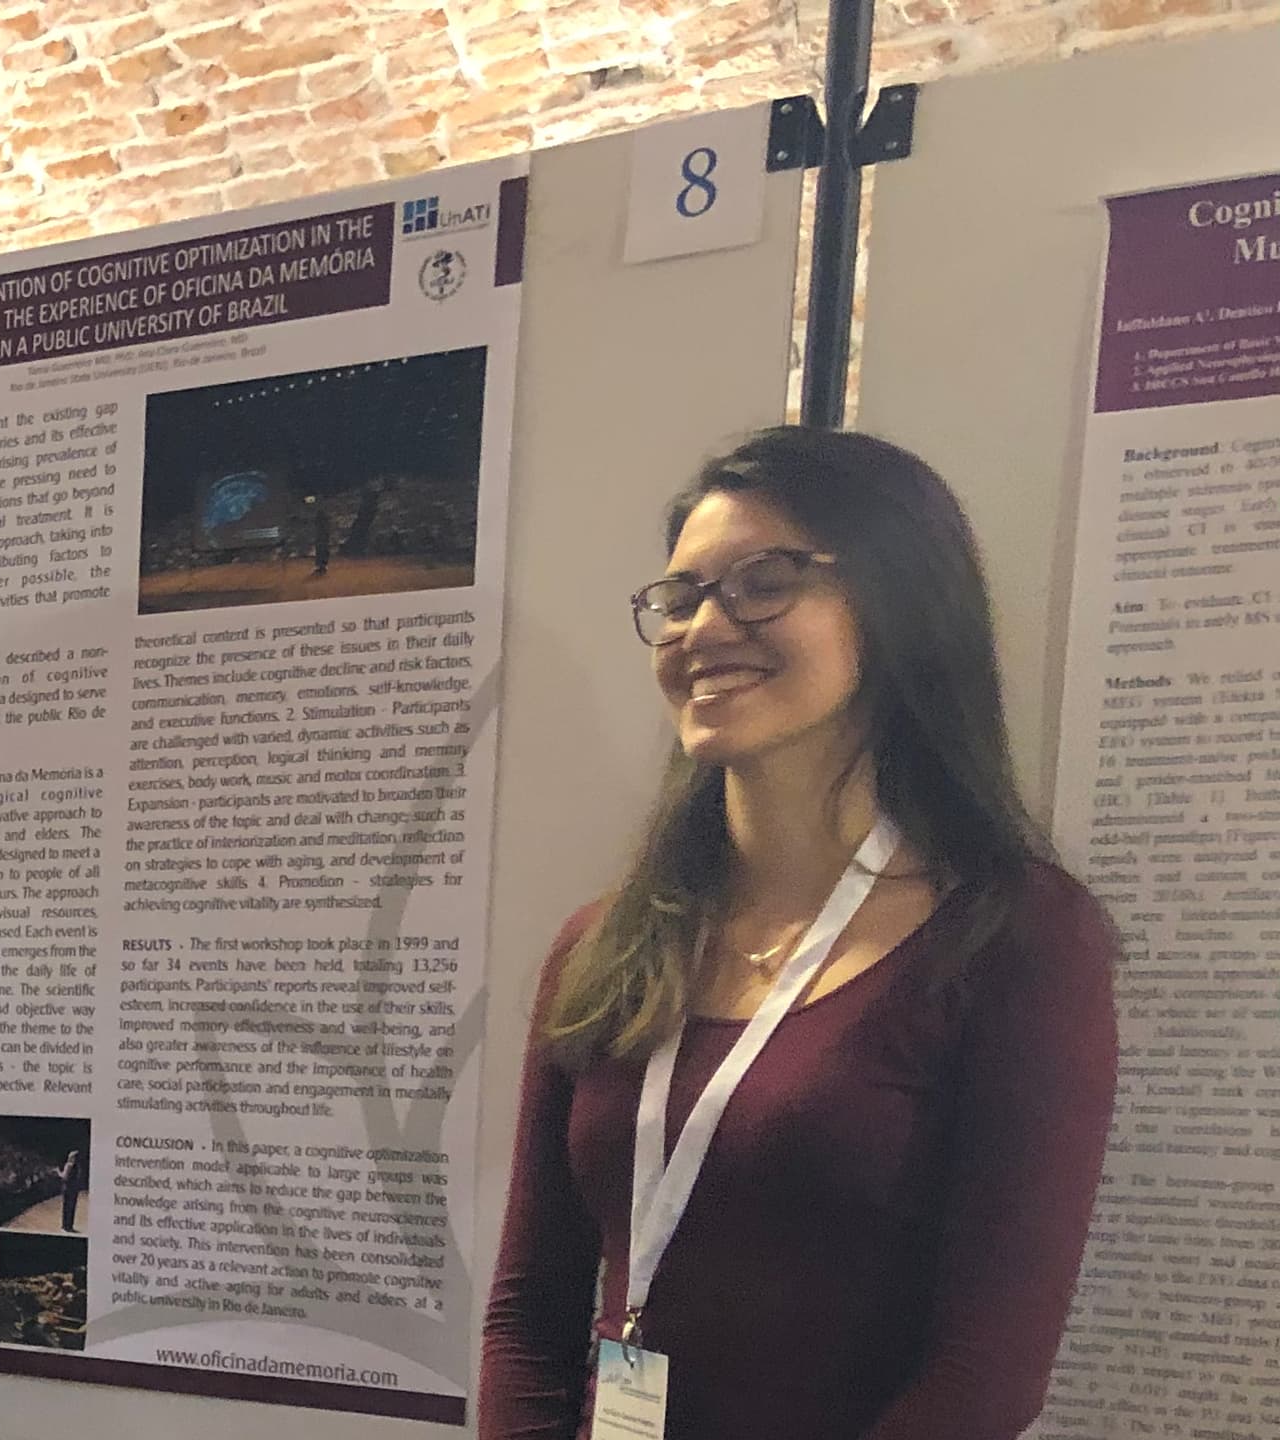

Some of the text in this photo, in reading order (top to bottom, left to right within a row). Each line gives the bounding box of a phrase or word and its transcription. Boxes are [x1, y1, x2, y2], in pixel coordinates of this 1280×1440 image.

[676, 147, 718, 217] 8
[1189, 189, 1280, 228] Cogni
[50, 270, 72, 292] OF
[77, 252, 169, 288] COGNITIVE
[174, 229, 305, 271] OPTIMIZATION
[310, 223, 330, 247] IN
[335, 215, 374, 241] THE
[4, 307, 34, 330] THE
[39, 288, 138, 324] EXPERIENCE
[143, 283, 166, 307] OF
[171, 270, 244, 301] OFICINA
[248, 266, 275, 289] DA
[279, 247, 375, 283] MEMÓRIA
[16, 336, 28, 355] A
[32, 325, 89, 352] PUBLIC
[94, 308, 194, 345] UNIVERSITY
[198, 302, 222, 327] OF
[227, 293, 288, 323] BRAZIL
[16, 414, 33, 425] the
[43, 406, 87, 423] existing
[96, 402, 118, 417] gap
[24, 433, 46, 446] and
[52, 430, 64, 441] its
[70, 422, 117, 440] effective
[36, 449, 97, 466] prevalence
[106, 441, 116, 454] of
[12, 472, 60, 488] pressing
[68, 466, 97, 480] need
[105, 463, 116, 475] to
[27, 492, 49, 505] that
[53, 491, 68, 504] go
[72, 484, 114, 502] beyond
[84, 506, 92, 518] It
[104, 504, 114, 516] is
[50, 527, 86, 545] taking
[90, 524, 112, 538] into
[50, 548, 88, 562] factors
[100, 544, 112, 557] to
[90, 565, 110, 578] the
[35, 590, 56, 604] that
[63, 586, 110, 603] promote
[6, 648, 59, 665] described
[67, 649, 73, 660] a
[123, 938, 171, 951] RESULTS
[190, 937, 210, 950] The
[215, 937, 238, 950] first
[242, 937, 303, 955] workshop
[307, 938, 334, 951] took
[339, 938, 372, 954] place
[396, 937, 428, 950] 1999
[433, 938, 459, 950] and
[116, 1136, 193, 1151] CONCLUSION
[156, 1349, 398, 1386] www.oficinadamemoria.com
